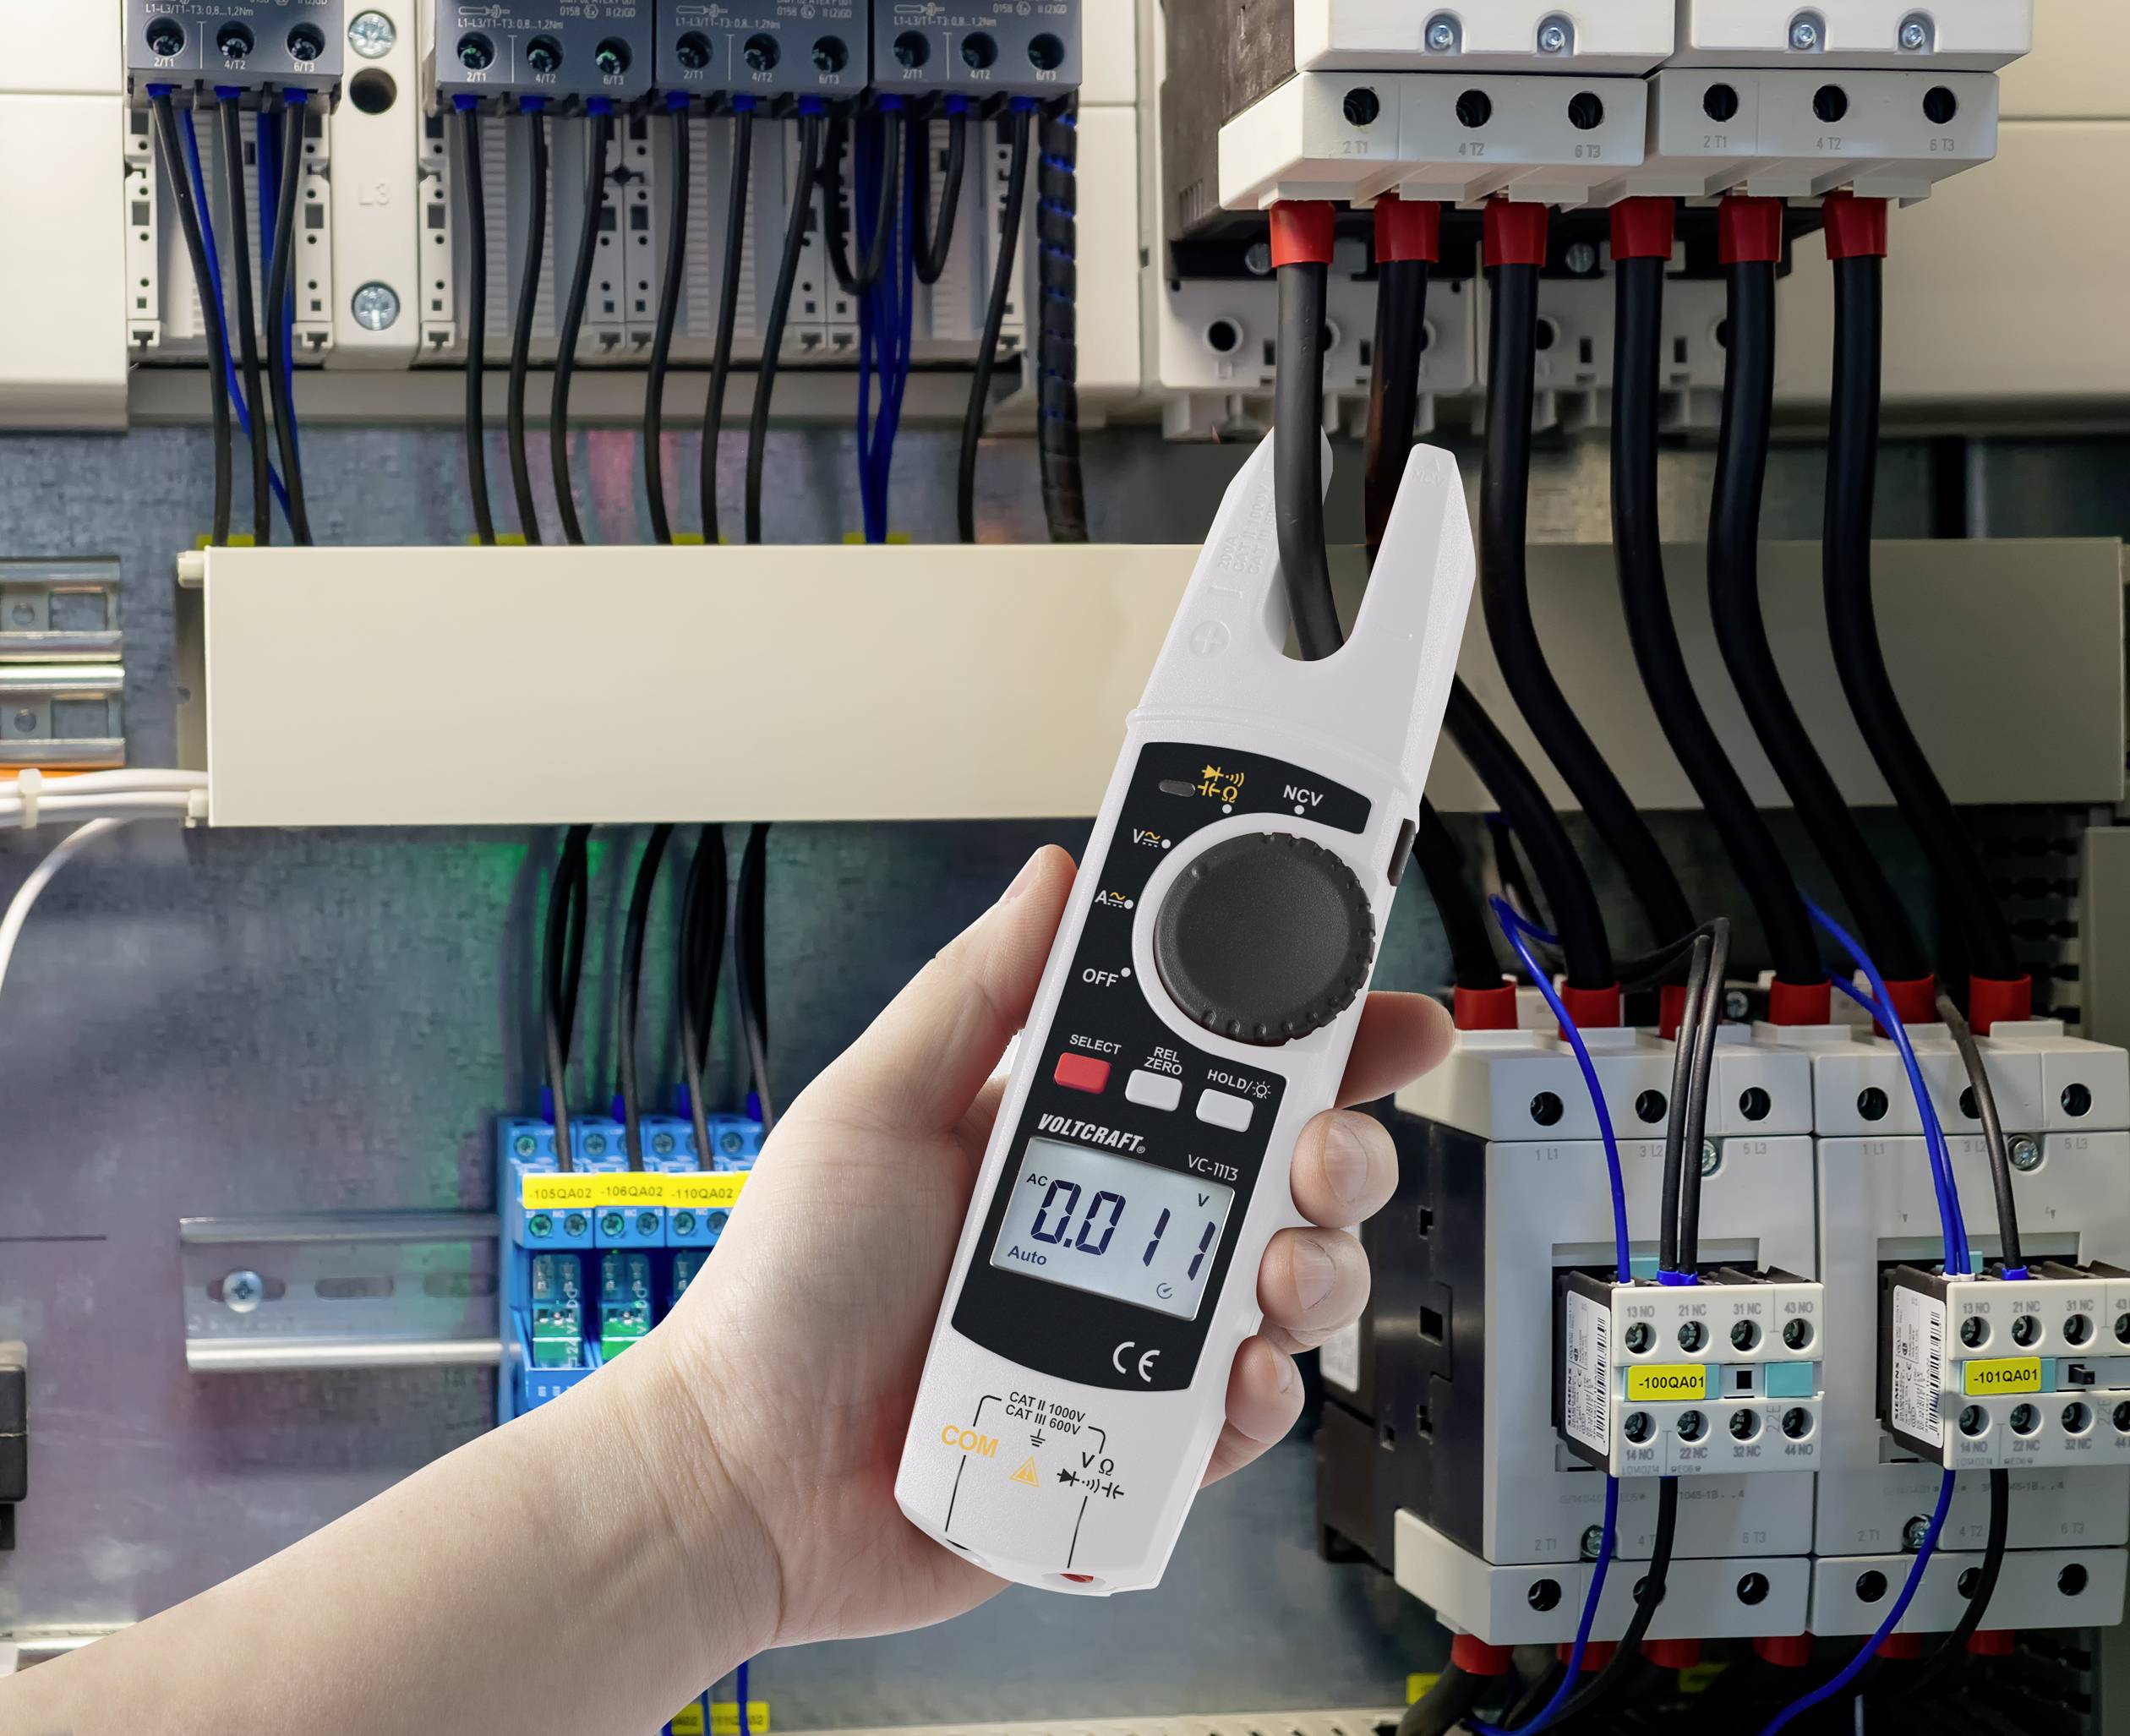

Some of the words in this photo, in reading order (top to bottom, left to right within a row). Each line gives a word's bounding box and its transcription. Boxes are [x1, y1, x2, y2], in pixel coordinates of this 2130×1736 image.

[154, 57, 175, 67] 2/T1
[224, 60, 246, 70] 4/T2
[294, 62, 315, 73] 6/T3
[467, 72, 487, 82] 2/T1
[535, 74, 556, 84] 4/T2
[604, 74, 624, 85] 6/T3
[684, 70, 703, 80] 2/T1
[751, 72, 773, 83] 4/T2
[818, 74, 839, 85] 6/T3
[903, 69, 922, 79] 2/T1
[970, 70, 991, 80] 4/T2
[1035, 70, 1057, 81] 6/T3
[1343, 141, 1352, 154] 2
[1355, 142, 1368, 155] T1
[1704, 135, 1711, 149] 2
[1715, 135, 1727, 149] T1
[1816, 137, 1823, 150] 4
[1828, 137, 1842, 150] T2
[1930, 139, 1937, 151] 6
[1942, 139, 1955, 152] T3
[1458, 143, 1466, 156] 4
[1470, 143, 1484, 156] T2
[1575, 145, 1583, 158] 6
[1587, 145, 1601, 158] T3
[358, 183, 390, 206] L3
[1282, 784, 1324, 807] NCV
[1082, 968, 1119, 987] OFF
[1069, 1034, 1122, 1056] SELECT
[1153, 1046, 1181, 1063] REL
[1144, 1056, 1182, 1075] ZERO
[1755, 1143, 1767, 1154] L3
[2076, 1138, 2088, 1149] L3
[1548, 1148, 1558, 1160] L1
[1652, 1145, 1663, 1157] L2
[1188, 1154, 1239, 1182] VC-1113
[1026, 1173, 1048, 1187] AC
[529, 1187, 592, 1198] -105QA02
[602, 1186, 663, 1197] -106QA02
[671, 1188, 733, 1198] -110QA02
[1198, 1193, 1210, 1207] V
[1030, 1179, 1216, 1281] 0.011
[1007, 1245, 1047, 1265] Auto
[1679, 1305, 1689, 1316] 21
[1691, 1305, 1706, 1316] NC
[1734, 1304, 1745, 1315] 31
[1747, 1303, 1761, 1314] NC
[1784, 1302, 1795, 1313] 43
[1798, 1302, 1813, 1313] NO
[1963, 1303, 1973, 1313] 13
[1975, 1302, 1990, 1313] NO
[2013, 1302, 2024, 1313] 21
[2025, 1302, 2040, 1312] NC
[2067, 1301, 2077, 1311] 31
[2079, 1300, 2094, 1311] NC
[2116, 1299, 2127, 1310] 43
[1626, 1307, 1637, 1318] 13
[1639, 1307, 1655, 1318] NO
[1112, 1341, 1161, 1383] CE
[1974, 1368, 2038, 1384] -101QA01
[1639, 1376, 1705, 1389] -100QA01
[1009, 1391, 1036, 1408] CAT
[1037, 1399, 1046, 1411] II
[1049, 1403, 1086, 1423] 1000V
[1005, 1404, 1032, 1422] CAT
[1034, 1411, 1046, 1426] III
[1049, 1417, 1081, 1436] 600V
[942, 1424, 999, 1458] COM
[1961, 1441, 1971, 1452] 14
[1974, 1440, 1988, 1452] NO
[2013, 1440, 2024, 1451] 22
[2025, 1439, 2040, 1451] NC
[2065, 1438, 2076, 1449] 32
[2078, 1438, 2092, 1449] NC
[1626, 1449, 1637, 1460] 14
[1639, 1449, 1653, 1460] NO
[1679, 1448, 1690, 1459] 22
[1693, 1447, 1707, 1459] NC
[1734, 1446, 1745, 1457] 32
[1747, 1445, 1761, 1457] NC
[1785, 1444, 1796, 1455] 44
[1798, 1444, 1813, 1455] NO
[1082, 1452, 1095, 1469] V
[1753, 1532, 1766, 1543] T3
[1868, 1530, 1880, 1541] T1
[1969, 1526, 1982, 1537] T2
[1545, 1539, 1557, 1550] T1
